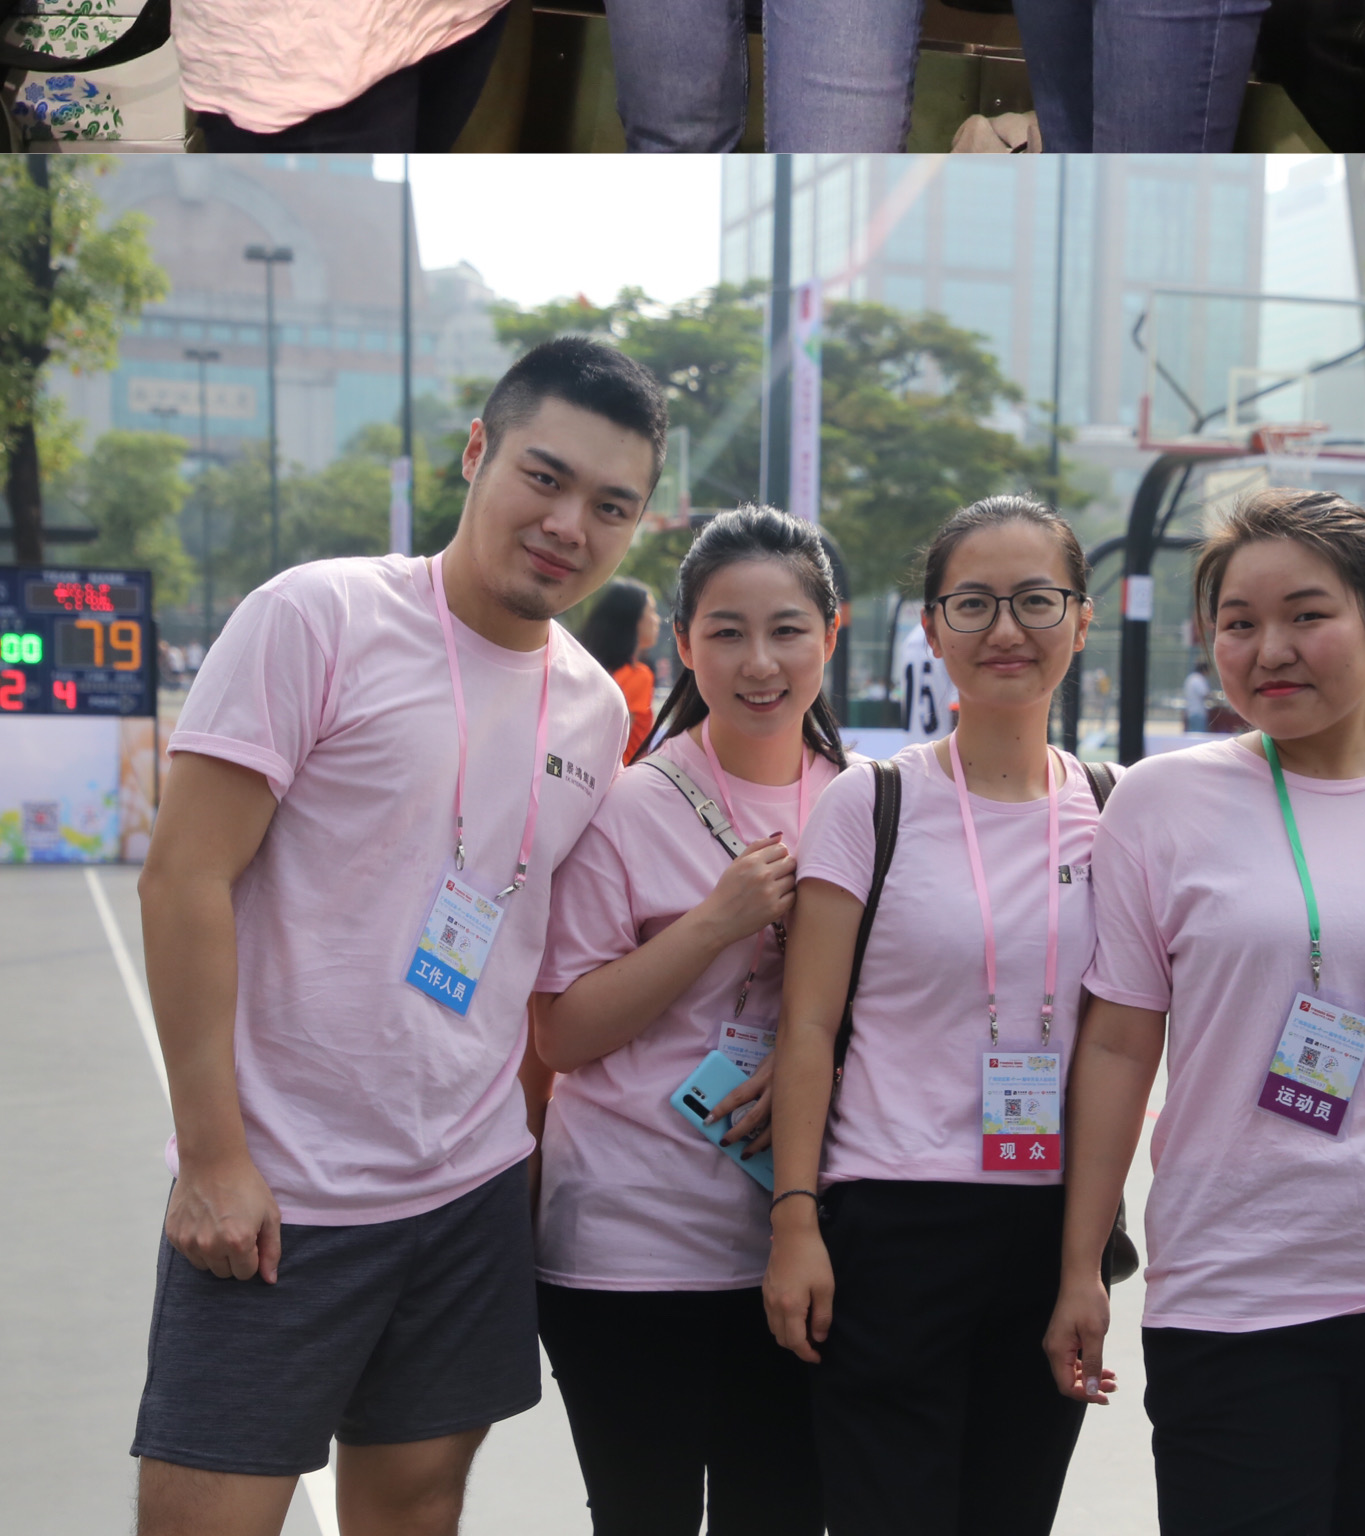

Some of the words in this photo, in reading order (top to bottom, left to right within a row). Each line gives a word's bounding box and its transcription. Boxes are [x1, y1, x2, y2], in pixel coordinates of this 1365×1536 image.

[75, 619, 142, 671] 79
[53, 680, 77, 710] 4
[415, 960, 466, 1002] 工作人员
[1275, 1085, 1333, 1122] 运动员
[999, 1141, 1046, 1161] 观众
